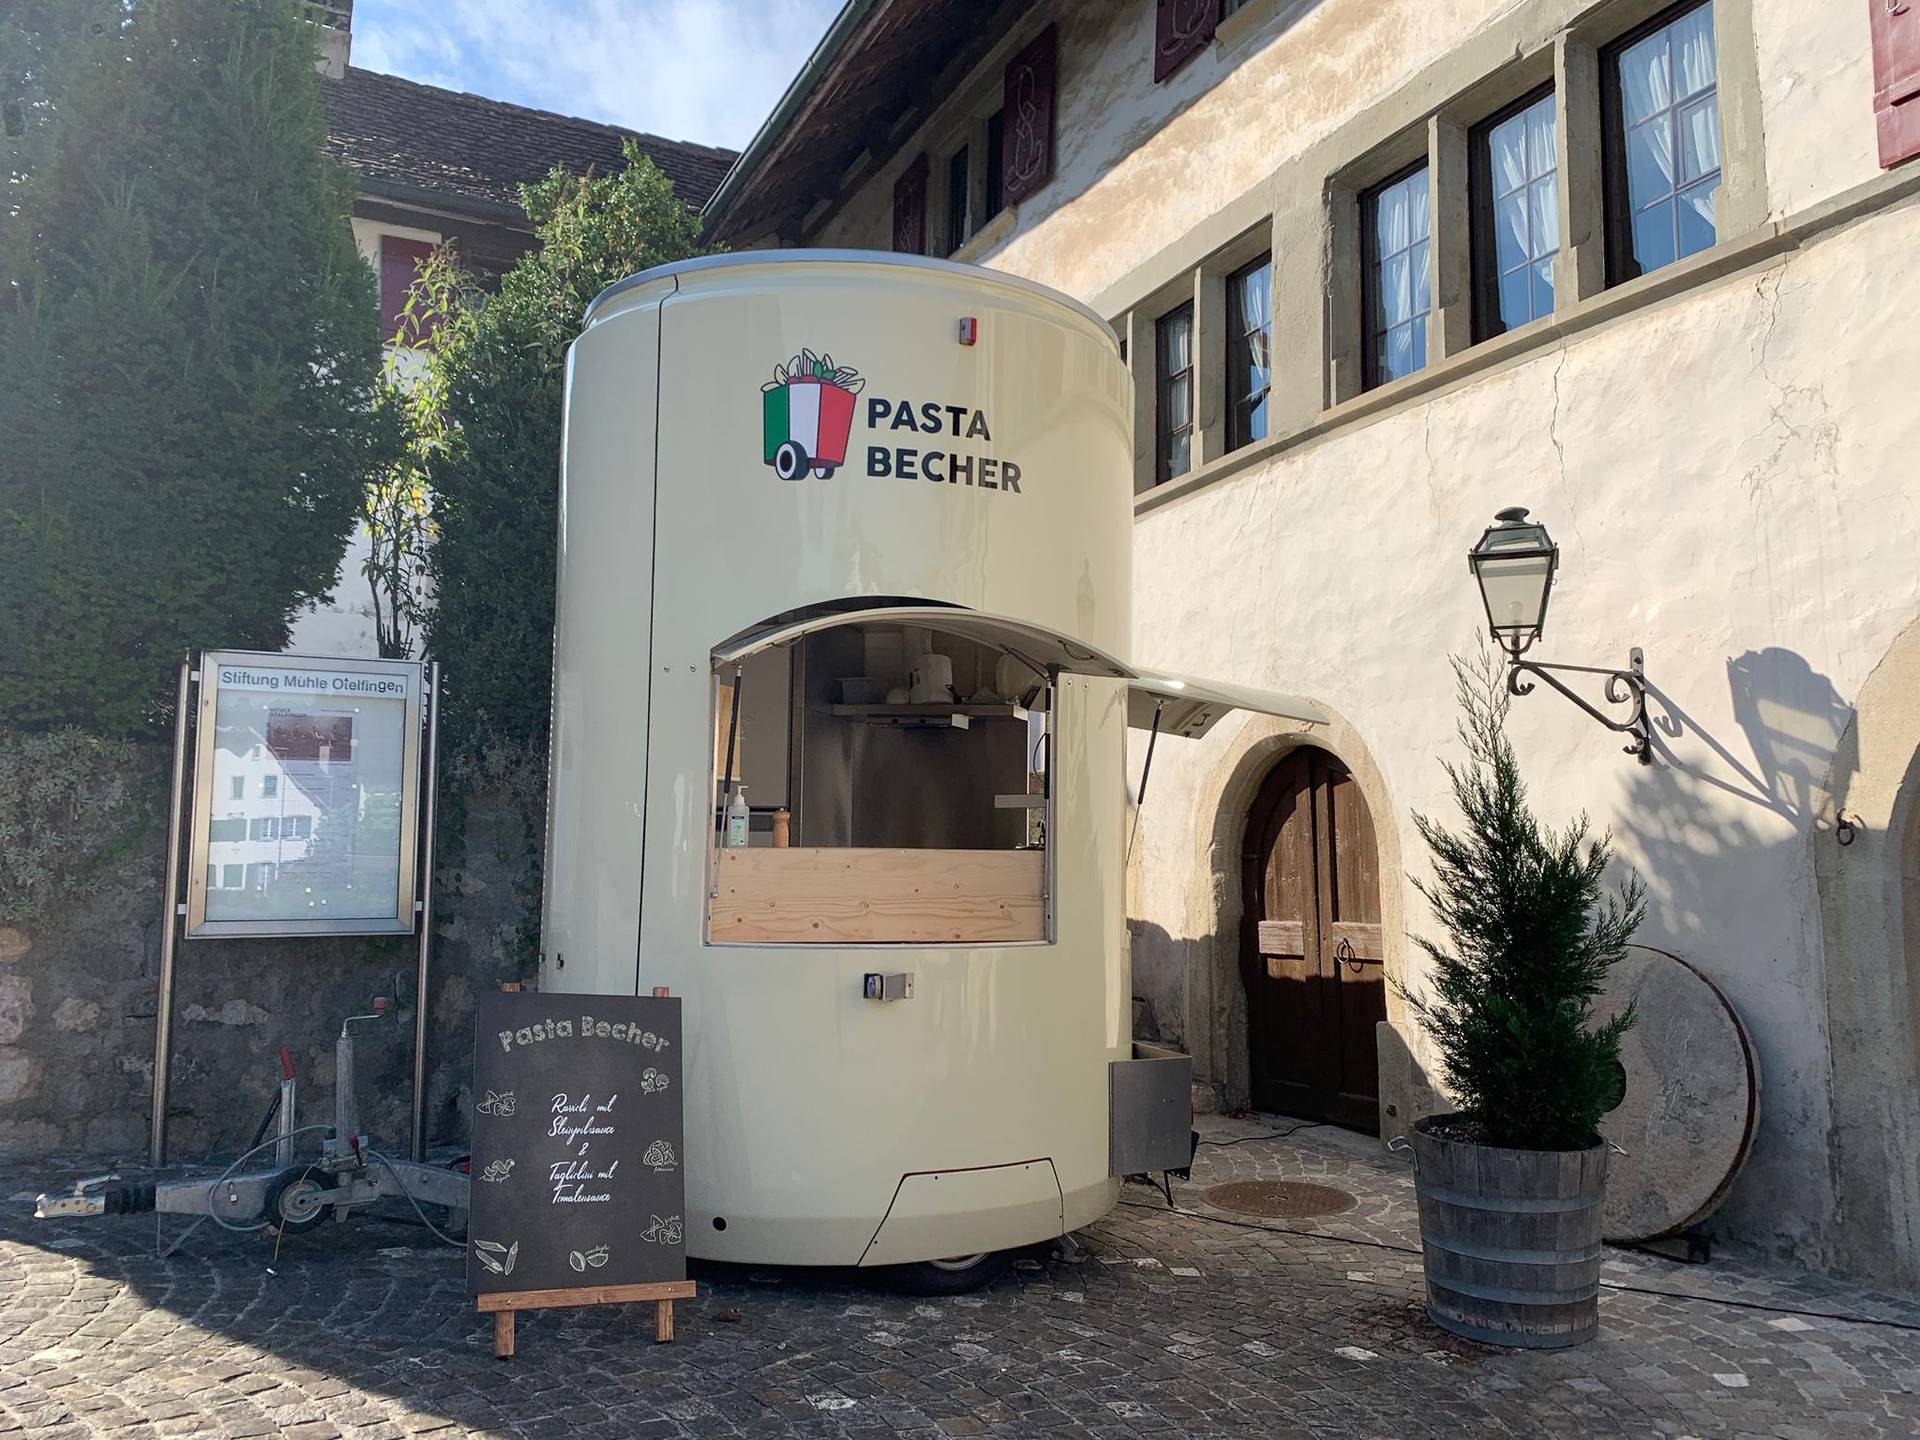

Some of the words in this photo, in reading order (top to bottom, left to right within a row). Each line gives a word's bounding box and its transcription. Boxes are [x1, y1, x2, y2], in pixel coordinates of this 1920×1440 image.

[867, 398, 990, 441] PASTA
[867, 446, 1022, 494] BECHER
[222, 671, 279, 688] Stiftung
[284, 675, 328, 689] Mühle
[499, 1018, 573, 1052] Pasta
[581, 1015, 670, 1053] Becher
[596, 1094, 618, 1113] mit
[578, 1142, 589, 1156] &
[597, 1160, 619, 1179] mit
[552, 1183, 611, 1204] Tomatensauce
